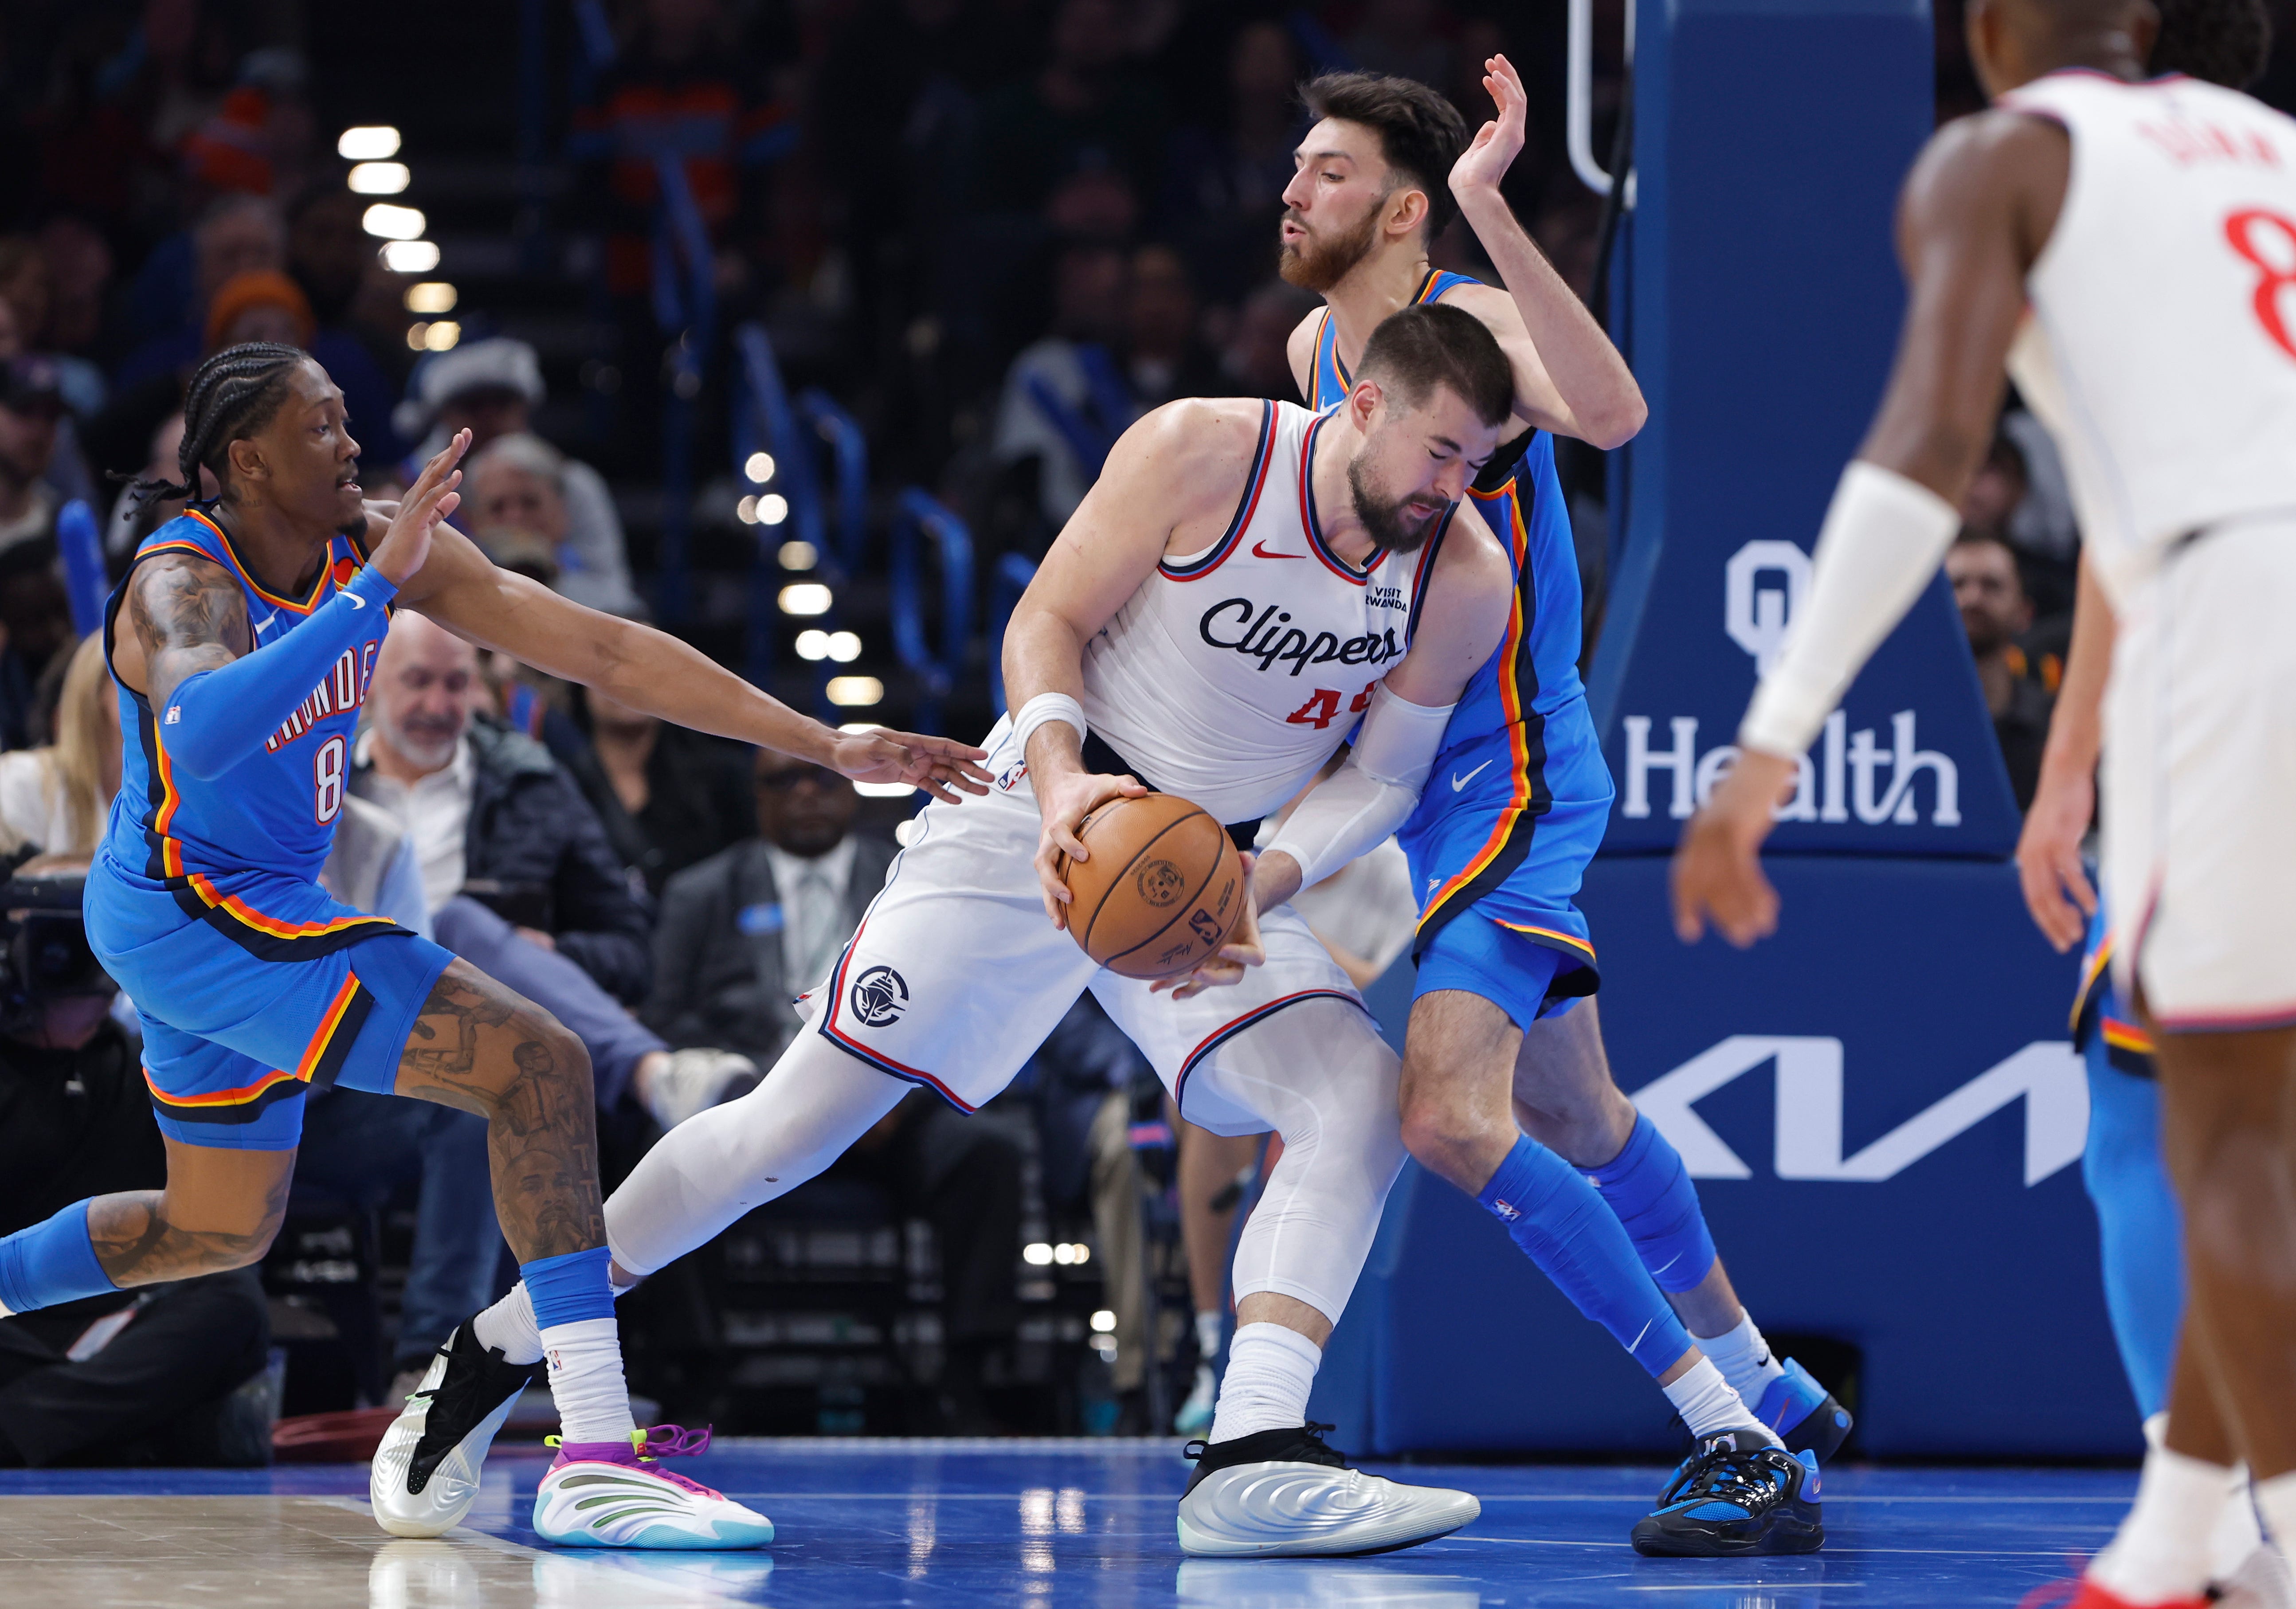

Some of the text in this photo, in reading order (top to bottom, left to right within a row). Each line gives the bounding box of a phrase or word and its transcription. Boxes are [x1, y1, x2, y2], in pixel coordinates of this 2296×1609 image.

[1375, 586, 1401, 599] VISIT
[1199, 597, 1403, 676] Clippers
[313, 734, 346, 826] 8
